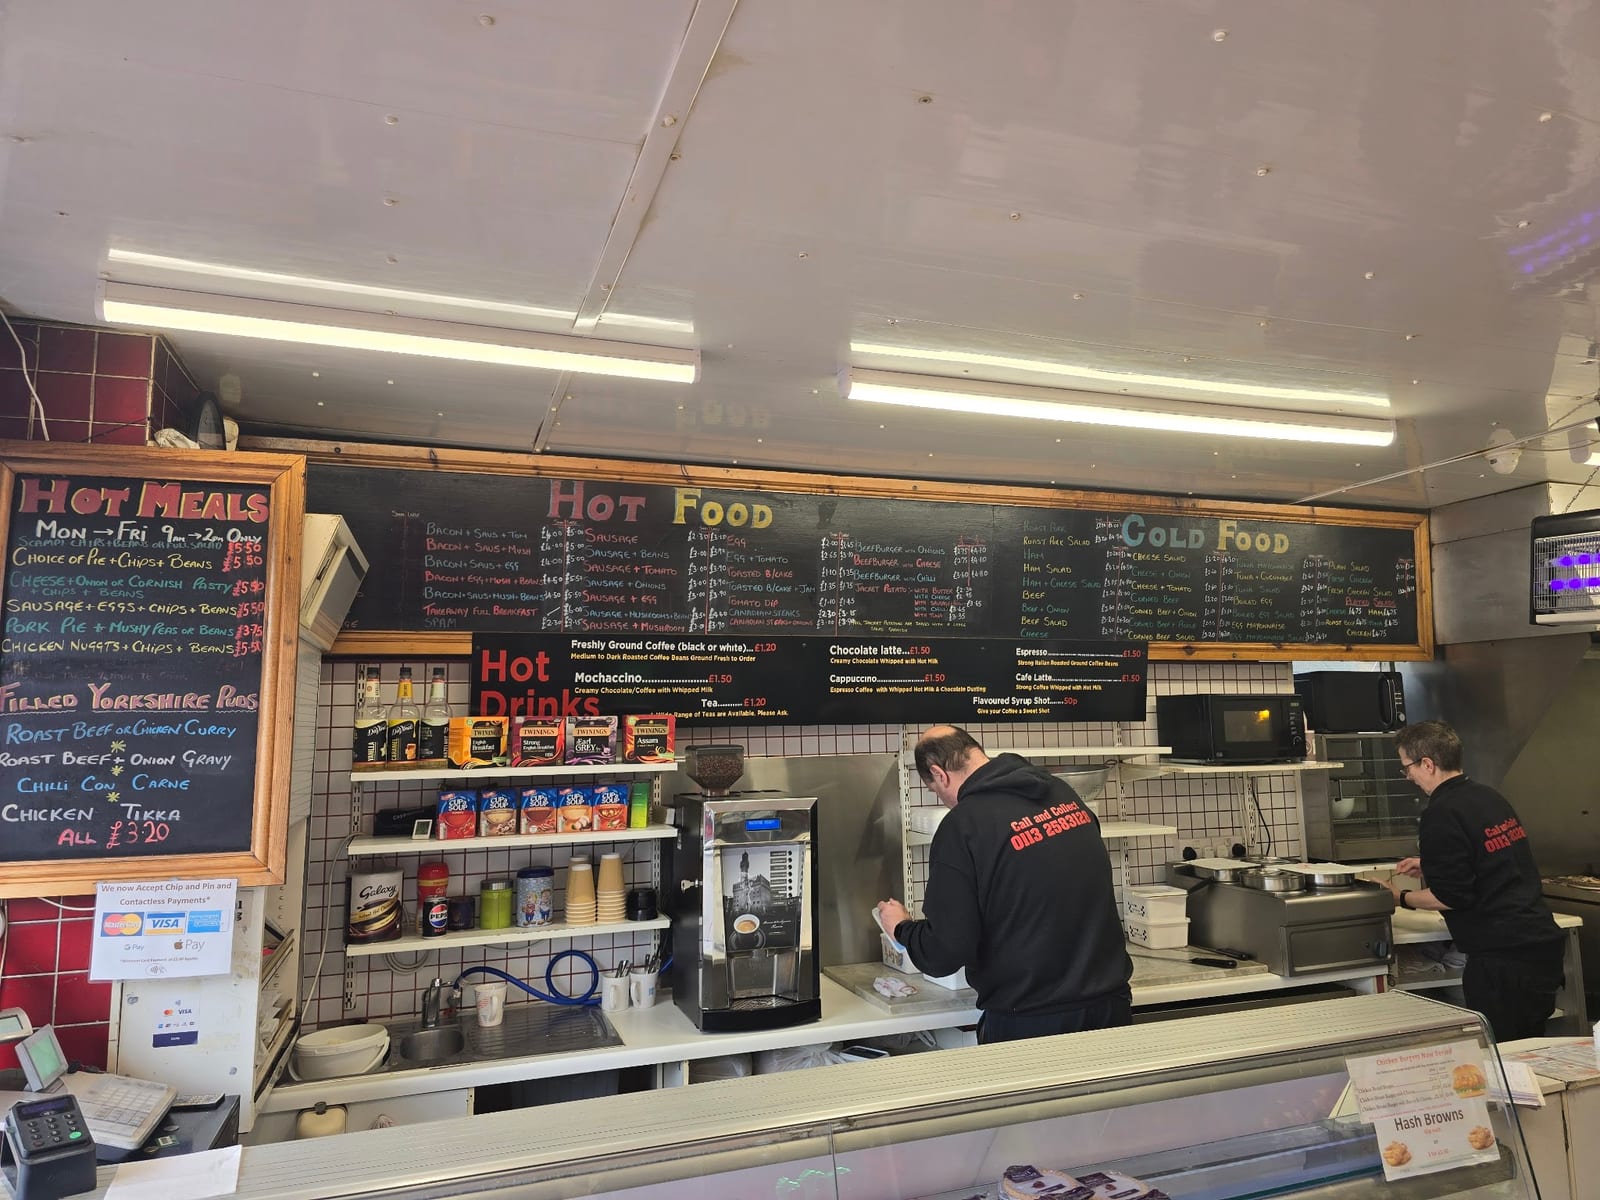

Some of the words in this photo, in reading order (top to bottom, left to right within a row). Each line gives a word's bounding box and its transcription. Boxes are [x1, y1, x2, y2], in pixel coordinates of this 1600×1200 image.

[19, 479, 130, 517] HOT
[137, 481, 269, 523] MEALS
[547, 480, 646, 521] HOT
[672, 488, 773, 528] FOOD
[36, 520, 86, 540] MON
[227, 528, 261, 543] ONLY
[426, 522, 462, 535] BACON
[474, 529, 498, 538] SAUS
[510, 531, 527, 539] TOM
[585, 528, 638, 544] SAUSAGE
[1121, 514, 1205, 549] COLD
[1217, 519, 1290, 554] FOOD
[12, 547, 65, 566] CHOICE
[69, 555, 84, 564] OF
[87, 547, 106, 565] PIE
[168, 554, 213, 569] BEANS
[585, 545, 630, 559] SAUSAGE
[641, 550, 669, 559] BEANS
[755, 555, 788, 564] TOMATO
[425, 555, 462, 568] BACON
[470, 560, 495, 568] SAUS
[584, 560, 631, 573] SAUSAGE
[641, 565, 677, 575] TOMATO
[1023, 563, 1041, 573] HAM
[727, 567, 761, 578] TOASTED
[129, 575, 182, 589] CORNISH
[192, 577, 233, 594] PASTY
[100, 588, 144, 599] BEANS
[7, 599, 84, 612] SAUSAGE
[199, 604, 237, 615] BEANS
[423, 603, 469, 617] TAKEAWAY
[473, 607, 490, 616] FULL
[493, 605, 538, 616] BREAKFAST
[5, 618, 50, 633] PORK
[60, 617, 86, 633] PIE
[109, 621, 151, 636] MUSHY
[152, 622, 178, 635] PEAS
[182, 626, 194, 635] OR
[200, 625, 234, 637] BEANS
[1, 639, 65, 654] CHICKEN
[190, 641, 235, 654] BEANS
[571, 640, 606, 650] Freshly
[608, 641, 643, 650] Ground
[645, 641, 675, 650] Coffee
[678, 642, 705, 652] (black
[755, 643, 777, 652] £1.20
[829, 645, 878, 655] Chocolate
[909, 646, 930, 655] £1.50
[1123, 650, 1141, 658] £1.50
[481, 650, 550, 682] Hot
[708, 674, 732, 684] £1.50
[925, 674, 945, 682] £1.50
[1016, 673, 1032, 681] Cafe
[0, 682, 78, 711] FILLED
[88, 682, 211, 710] YORKSHIRE
[216, 684, 259, 710] PUDS
[575, 687, 599, 695] Creamy
[672, 686, 699, 694] Whipped
[480, 689, 600, 717] Drinks
[744, 697, 766, 707] £1.20
[973, 697, 1010, 705] Flavoured
[1011, 697, 1032, 706] Syrup
[1064, 698, 1078, 706] 50p
[6, 723, 70, 744] ROAST
[73, 721, 114, 739] BEEF
[133, 719, 182, 737] CHICKEN
[184, 719, 237, 738] CURRY
[636, 727, 667, 735] TWININGS
[0, 752, 56, 766] ROAST
[62, 751, 112, 765] BEEF
[130, 754, 176, 766] ONION
[182, 750, 233, 770] GRAVY
[17, 777, 68, 793] CHILLI
[81, 775, 115, 791] CON
[132, 773, 191, 791] CARNE
[2, 804, 94, 822] CHICKEN
[120, 803, 181, 821] TIKKA
[1010, 816, 1034, 832] Call
[1033, 809, 1052, 824] and
[58, 829, 97, 846] ALL
[106, 821, 170, 849] £3.20
[1010, 827, 1044, 851] 0113
[101, 884, 115, 893] We
[136, 884, 164, 893] Accept
[165, 882, 183, 892] Chip
[185, 883, 200, 891] and
[202, 882, 215, 890] Pin
[216, 882, 232, 890] and
[359, 884, 397, 900] Galaxy
[120, 898, 165, 906] Contactless
[151, 919, 179, 929] VISA
[185, 939, 206, 952] Pay
[1393, 1114, 1422, 1132] Hash
[1423, 1109, 1464, 1127] Browns
